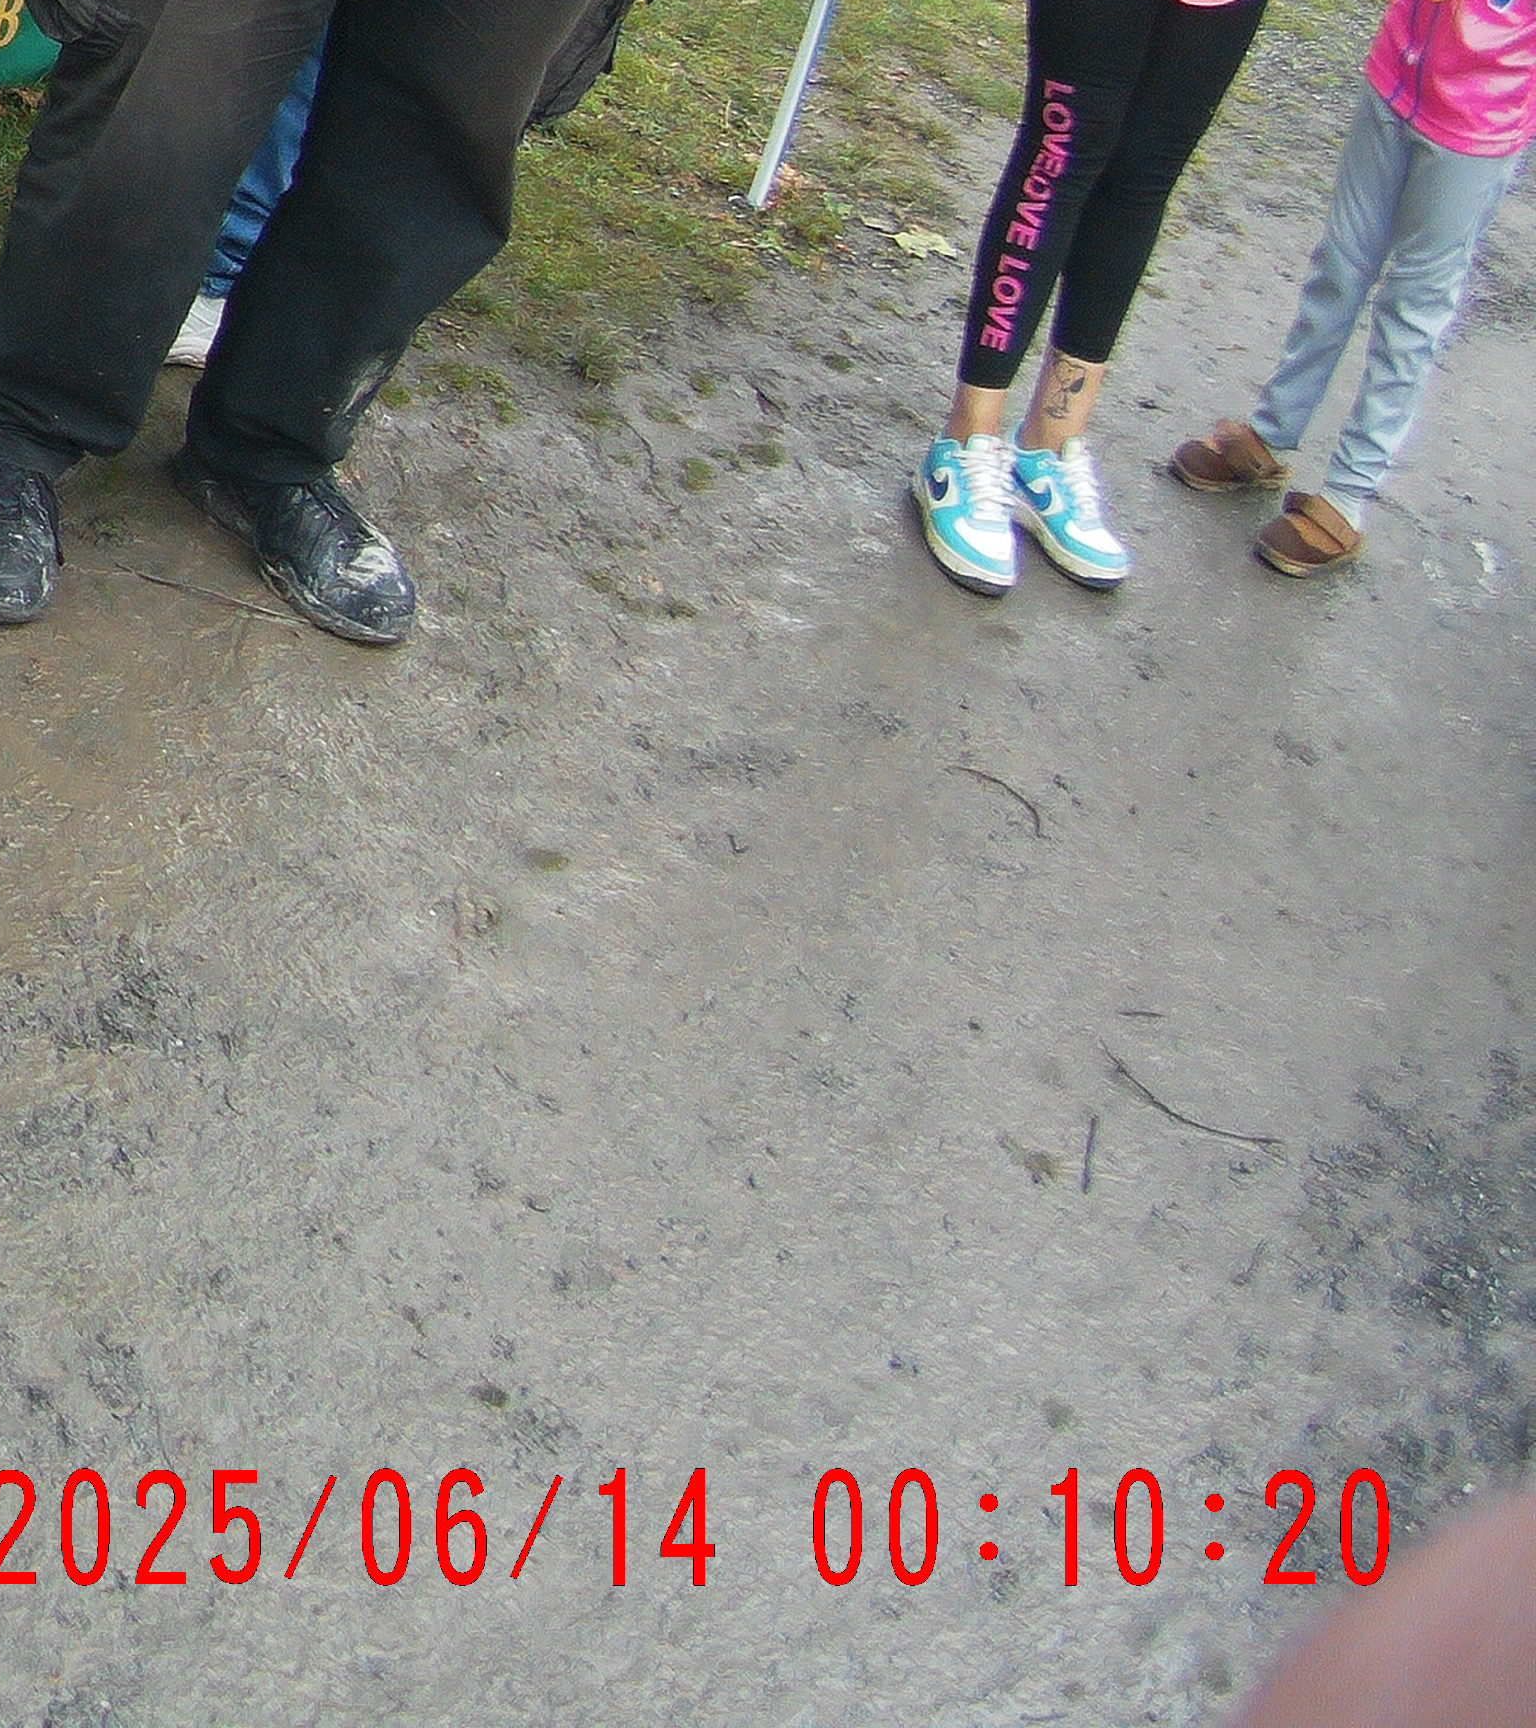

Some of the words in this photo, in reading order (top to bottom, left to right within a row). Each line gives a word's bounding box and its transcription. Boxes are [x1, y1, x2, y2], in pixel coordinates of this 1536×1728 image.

[1029, 78, 1077, 178] LOVE
[1005, 174, 1055, 251] OVE
[980, 253, 1030, 353] LOVE
